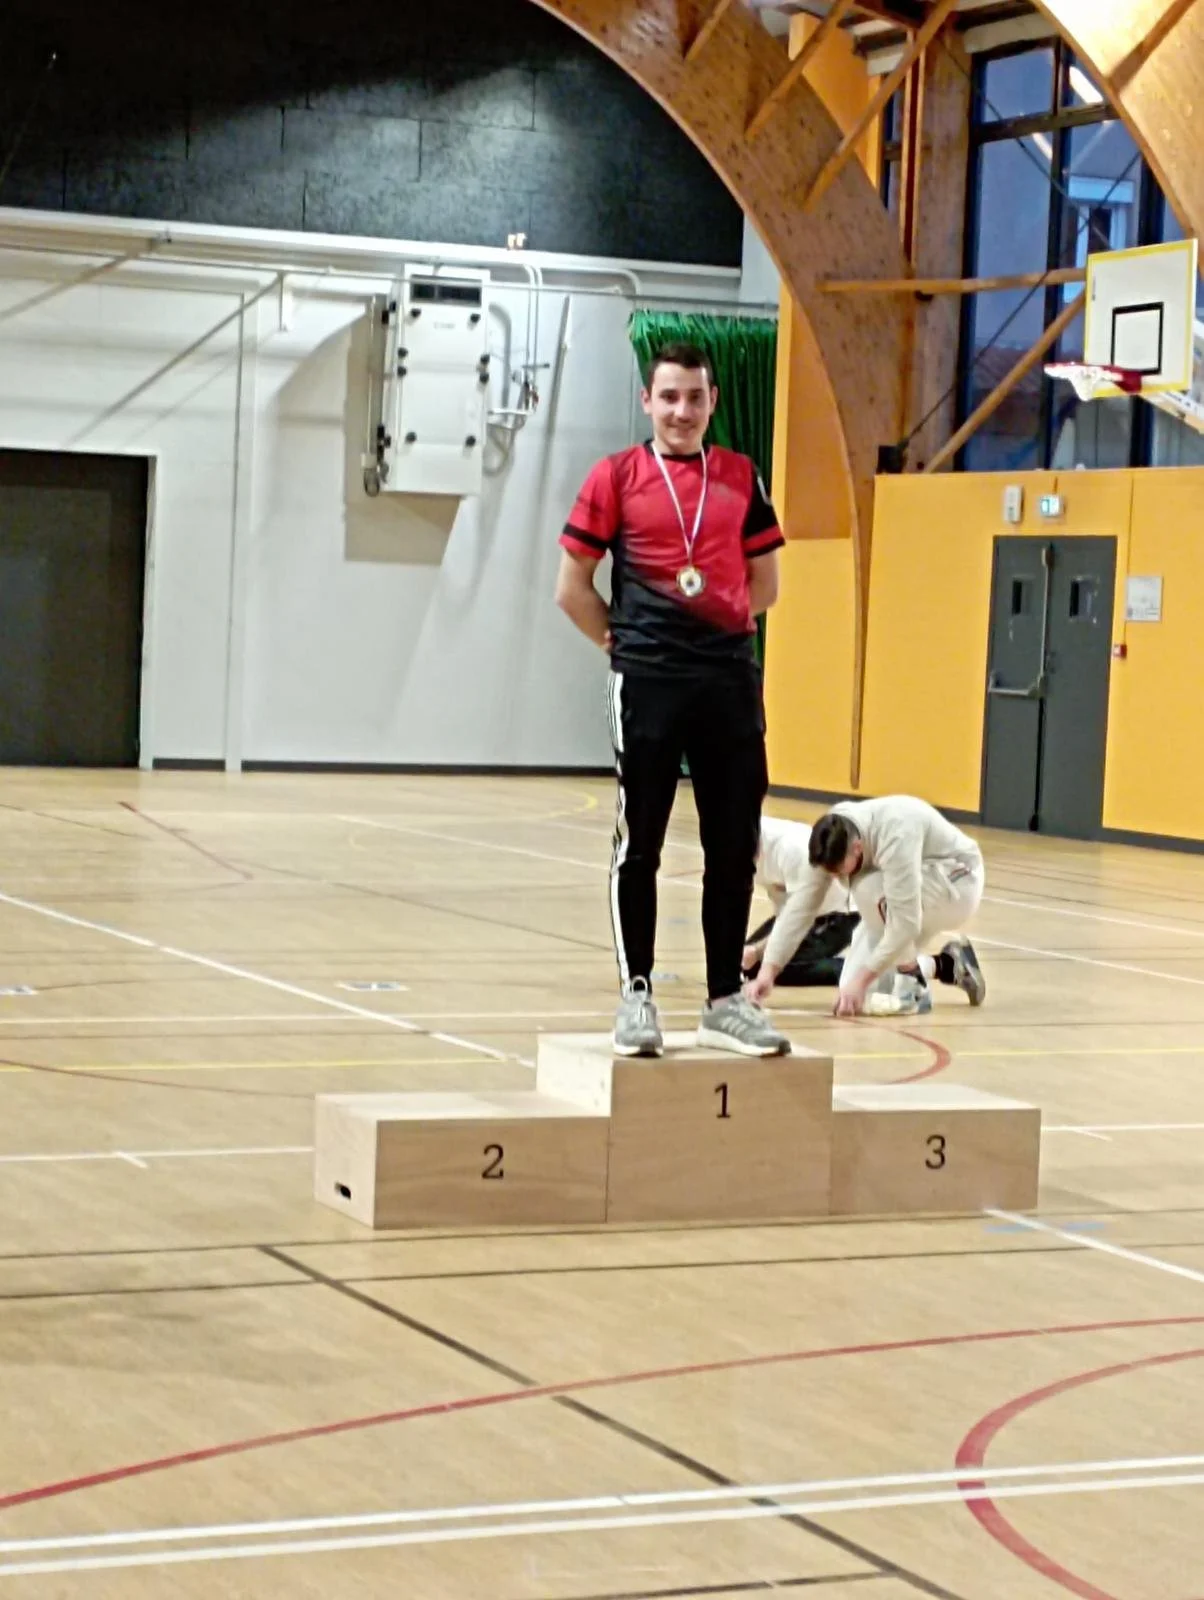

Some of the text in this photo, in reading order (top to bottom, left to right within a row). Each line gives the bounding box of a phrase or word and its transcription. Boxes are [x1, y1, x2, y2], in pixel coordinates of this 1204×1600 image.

[714, 1082, 732, 1119] 1
[481, 1143, 505, 1180] 2
[924, 1134, 947, 1170] 3
